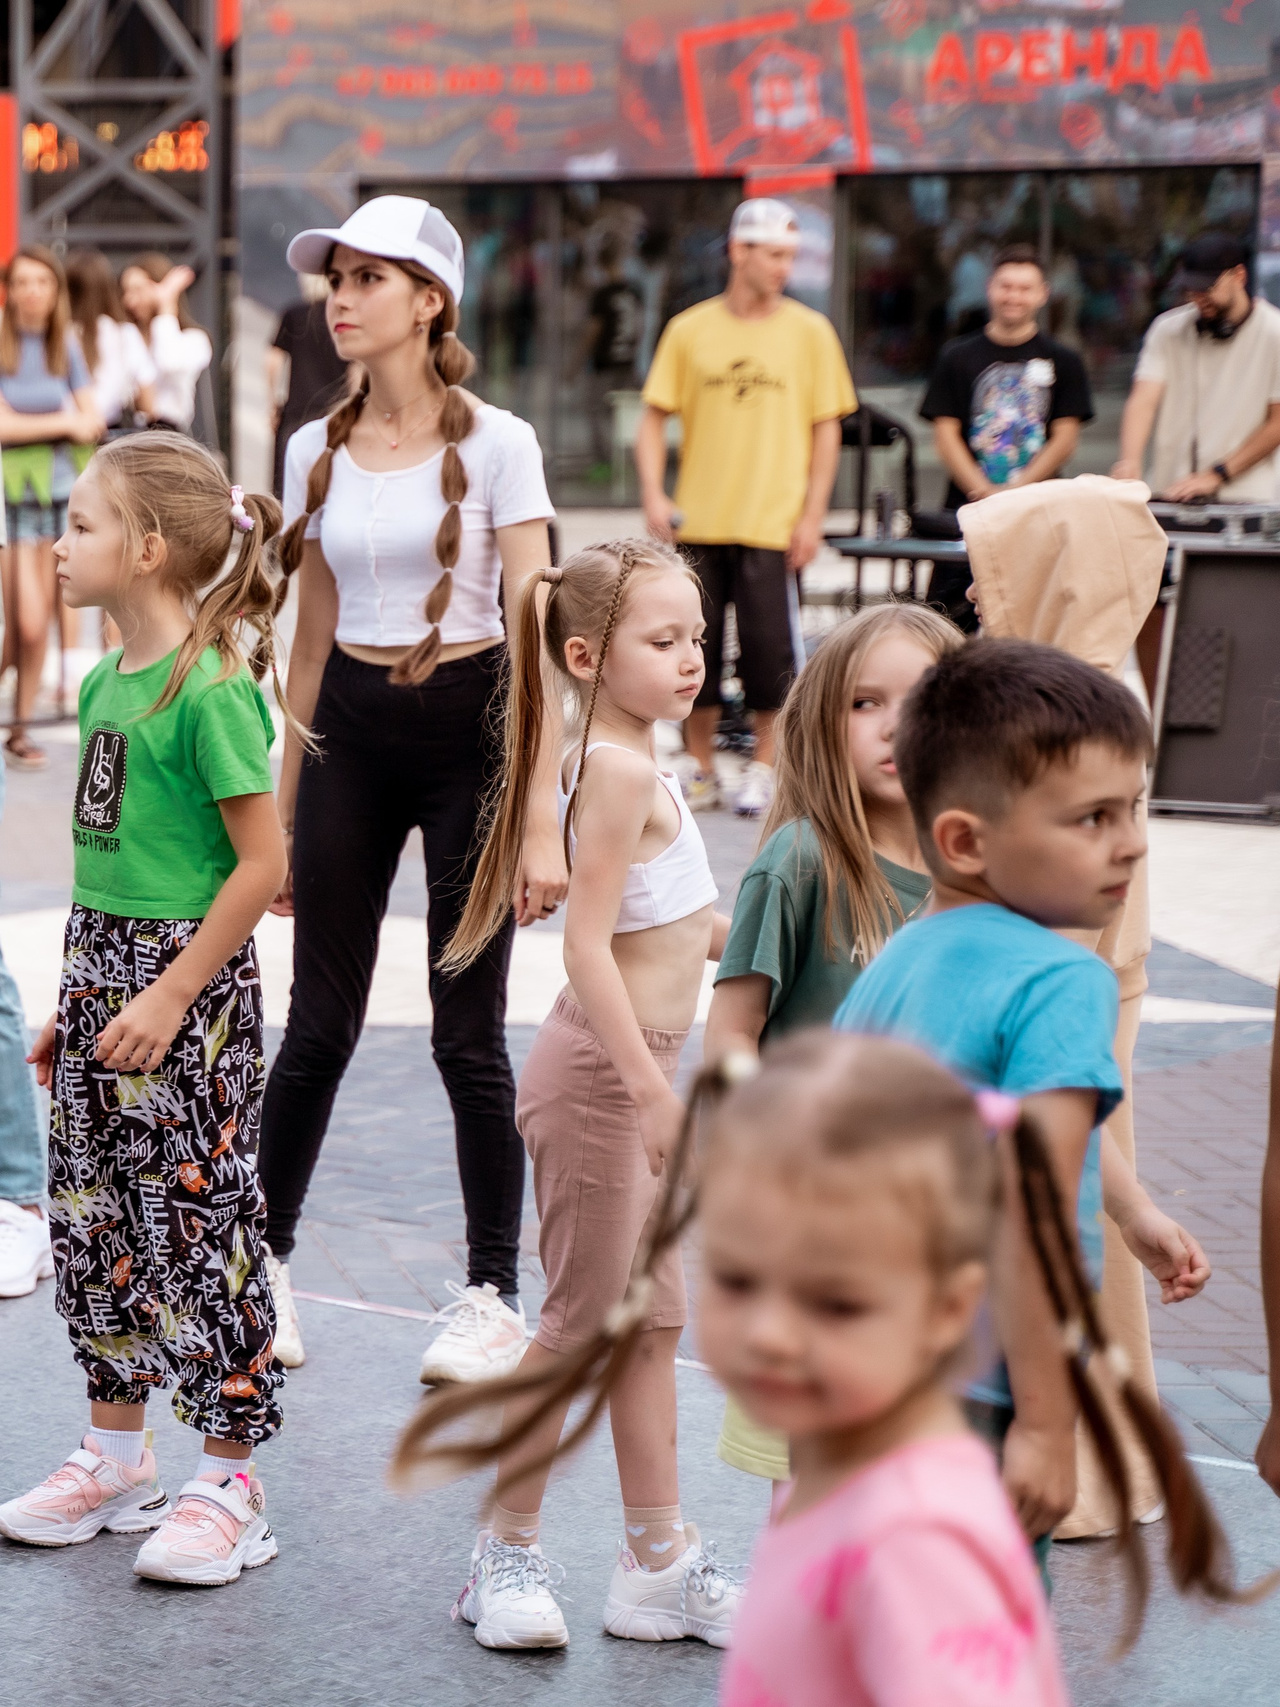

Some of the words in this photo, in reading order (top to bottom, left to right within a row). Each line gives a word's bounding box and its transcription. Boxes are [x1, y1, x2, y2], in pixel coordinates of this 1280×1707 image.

[925, 24, 1213, 95] АРЕНДА
[94, 834, 121, 855] POWER
[136, 932, 160, 944] LOCO
[69, 986, 100, 999] LOCO
[216, 1077, 226, 1103] LOCO
[154, 1116, 180, 1127] LOCO
[163, 1126, 205, 1166] SAY
[138, 1172, 163, 1182] LOCO
[89, 1220, 117, 1238] LOCO
[99, 1226, 134, 1270] SAY
[84, 1282, 107, 1291] LOCO
[133, 1372, 163, 1382] LOCO
